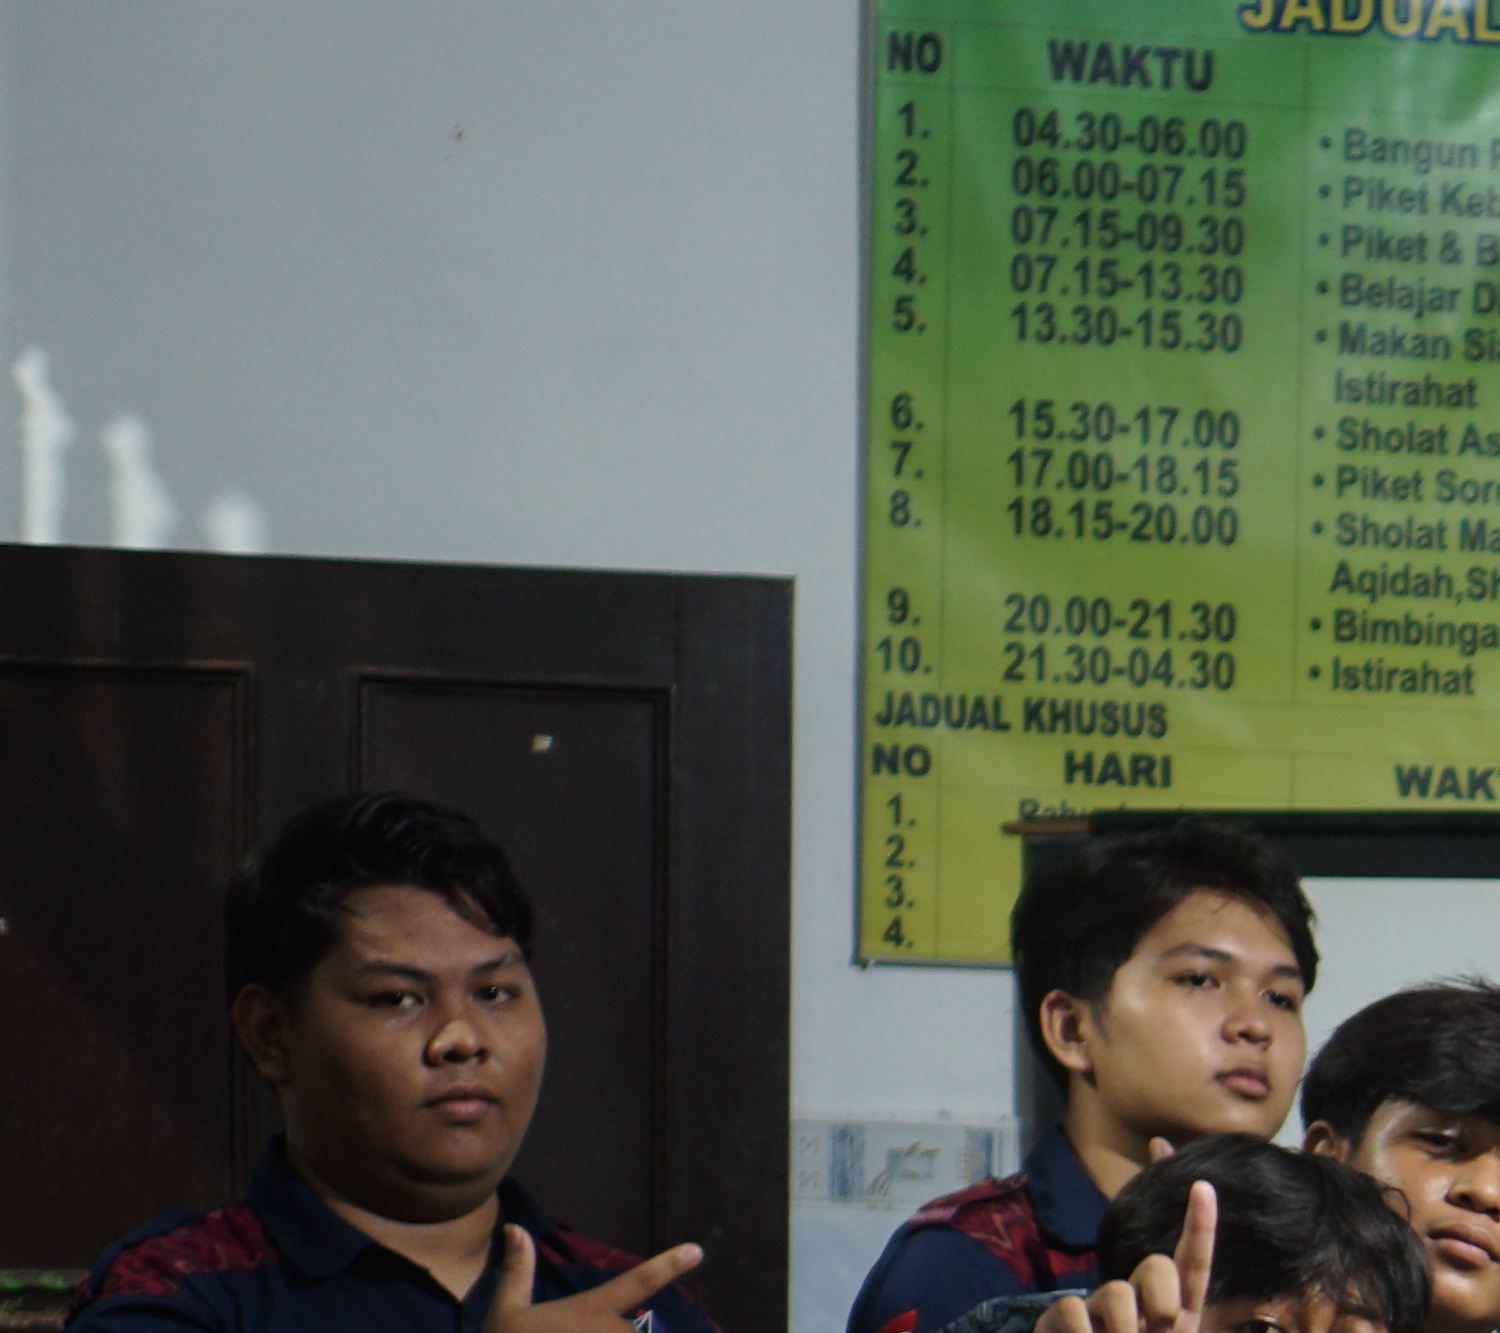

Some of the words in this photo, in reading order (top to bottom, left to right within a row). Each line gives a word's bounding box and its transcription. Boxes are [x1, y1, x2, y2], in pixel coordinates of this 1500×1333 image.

[887, 30, 943, 74] NO
[1047, 38, 1215, 91] WAKTU
[897, 100, 931, 140] 1.
[1013, 107, 1247, 159] 04.30-06.00
[895, 149, 929, 188] 2.
[1344, 126, 1478, 174] Bangun
[1011, 155, 1246, 208] 06.00-07.15
[1342, 175, 1427, 215] Piket
[894, 198, 928, 237] 3.
[1010, 205, 1245, 256] 07.15-09.30
[1340, 223, 1427, 263] Piket
[1439, 230, 1463, 265] &
[893, 247, 927, 285] 4.
[1009, 252, 1245, 306] 07.15-13.30
[893, 294, 927, 334] 5.
[1340, 272, 1463, 320] Belajar
[1010, 301, 1243, 353] 13.30-15.30
[1338, 320, 1451, 360] Makan
[1335, 368, 1478, 410] Istirahat
[890, 392, 924, 431] 6.
[1008, 397, 1240, 449] 15.30-17.00
[1336, 415, 1449, 456] Sholat
[889, 440, 923, 479] 7.
[1007, 446, 1240, 498] 17.00-18.15
[1335, 465, 1424, 503] Piket
[888, 489, 923, 529] 8.
[1007, 495, 1238, 546] 18.15-20.00
[1336, 512, 1448, 552] Sholat
[887, 586, 921, 626] 9.
[1003, 592, 1237, 643] 20.00-21.30
[877, 635, 933, 675] 10.
[1003, 641, 1236, 690] 21.30-04.30
[1332, 656, 1475, 697] Istirahat
[876, 690, 1010, 732] JADUAL
[1023, 696, 1168, 739] KHUSUS
[871, 743, 932, 777] NO
[1064, 750, 1172, 789] HARI
[887, 792, 917, 828] 1.
[884, 835, 916, 869] 2.
[886, 875, 915, 909] 3.
[883, 915, 914, 949] 4.
